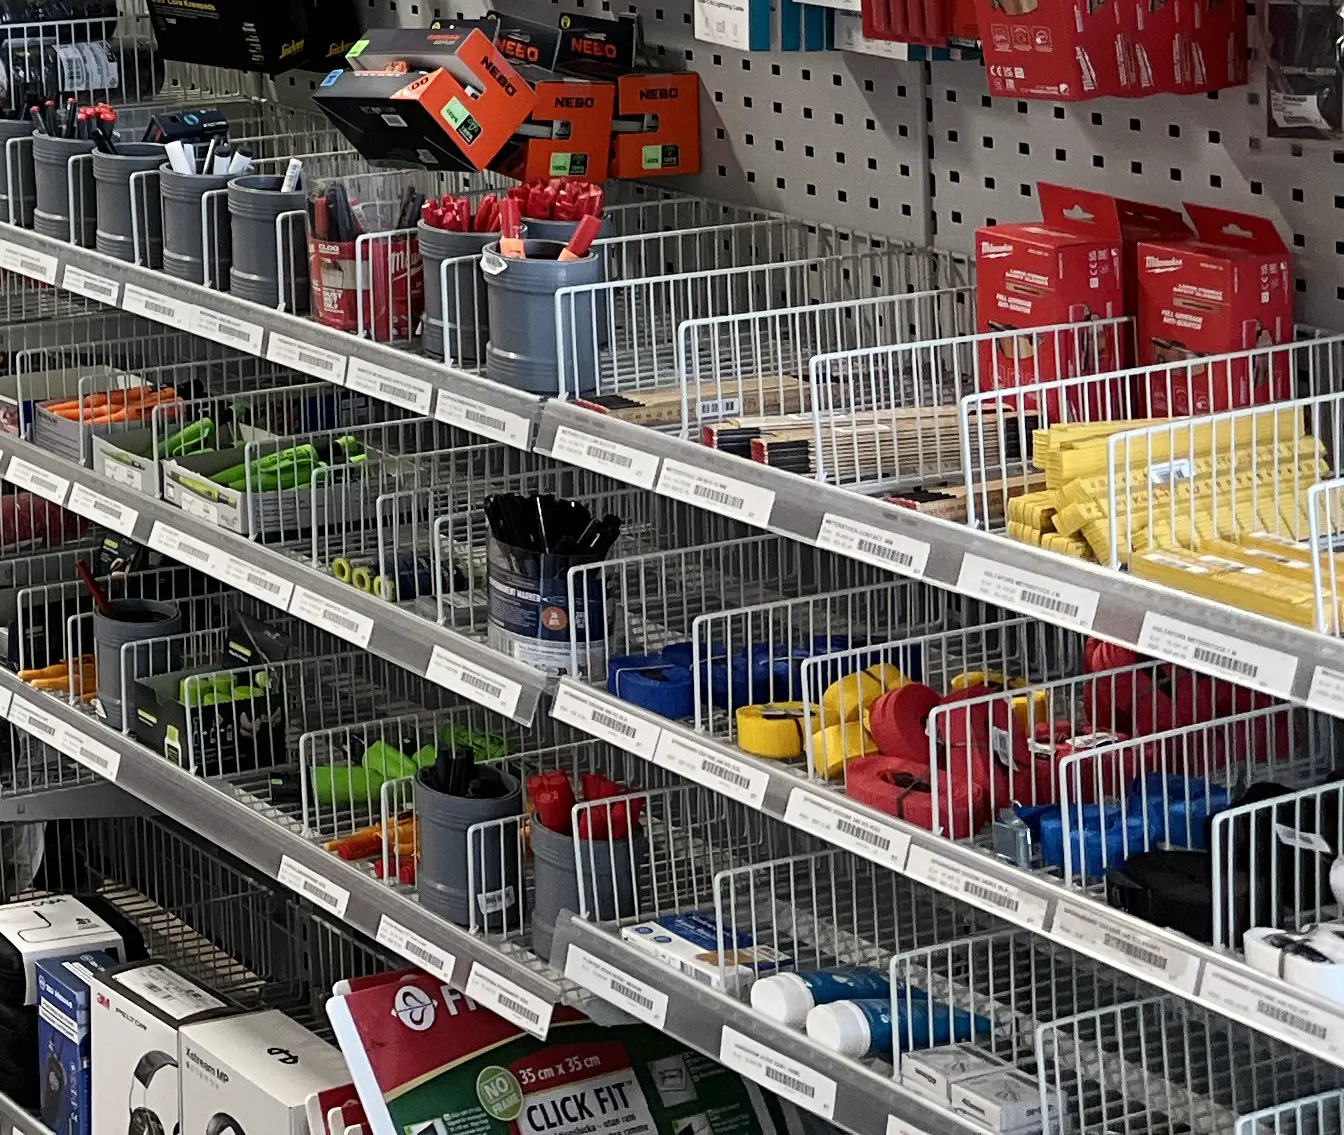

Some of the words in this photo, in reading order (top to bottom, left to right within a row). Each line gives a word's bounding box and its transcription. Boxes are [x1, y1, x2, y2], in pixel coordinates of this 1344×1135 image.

[571, 38, 617, 59] NEBO
[480, 55, 518, 97] NEBO
[555, 96, 595, 108] NEBO
[640, 88, 679, 101] NEBO
[96, 992, 110, 1009] 3M
[519, 1068, 536, 1085] 35
[537, 1069, 555, 1082] cm
[557, 1065, 565, 1075] x
[565, 1057, 582, 1073] 35
[583, 1054, 602, 1069] cm
[483, 1076, 509, 1098] NO
[526, 1092, 598, 1133] CLICK
[598, 1080, 632, 1115] FIT
